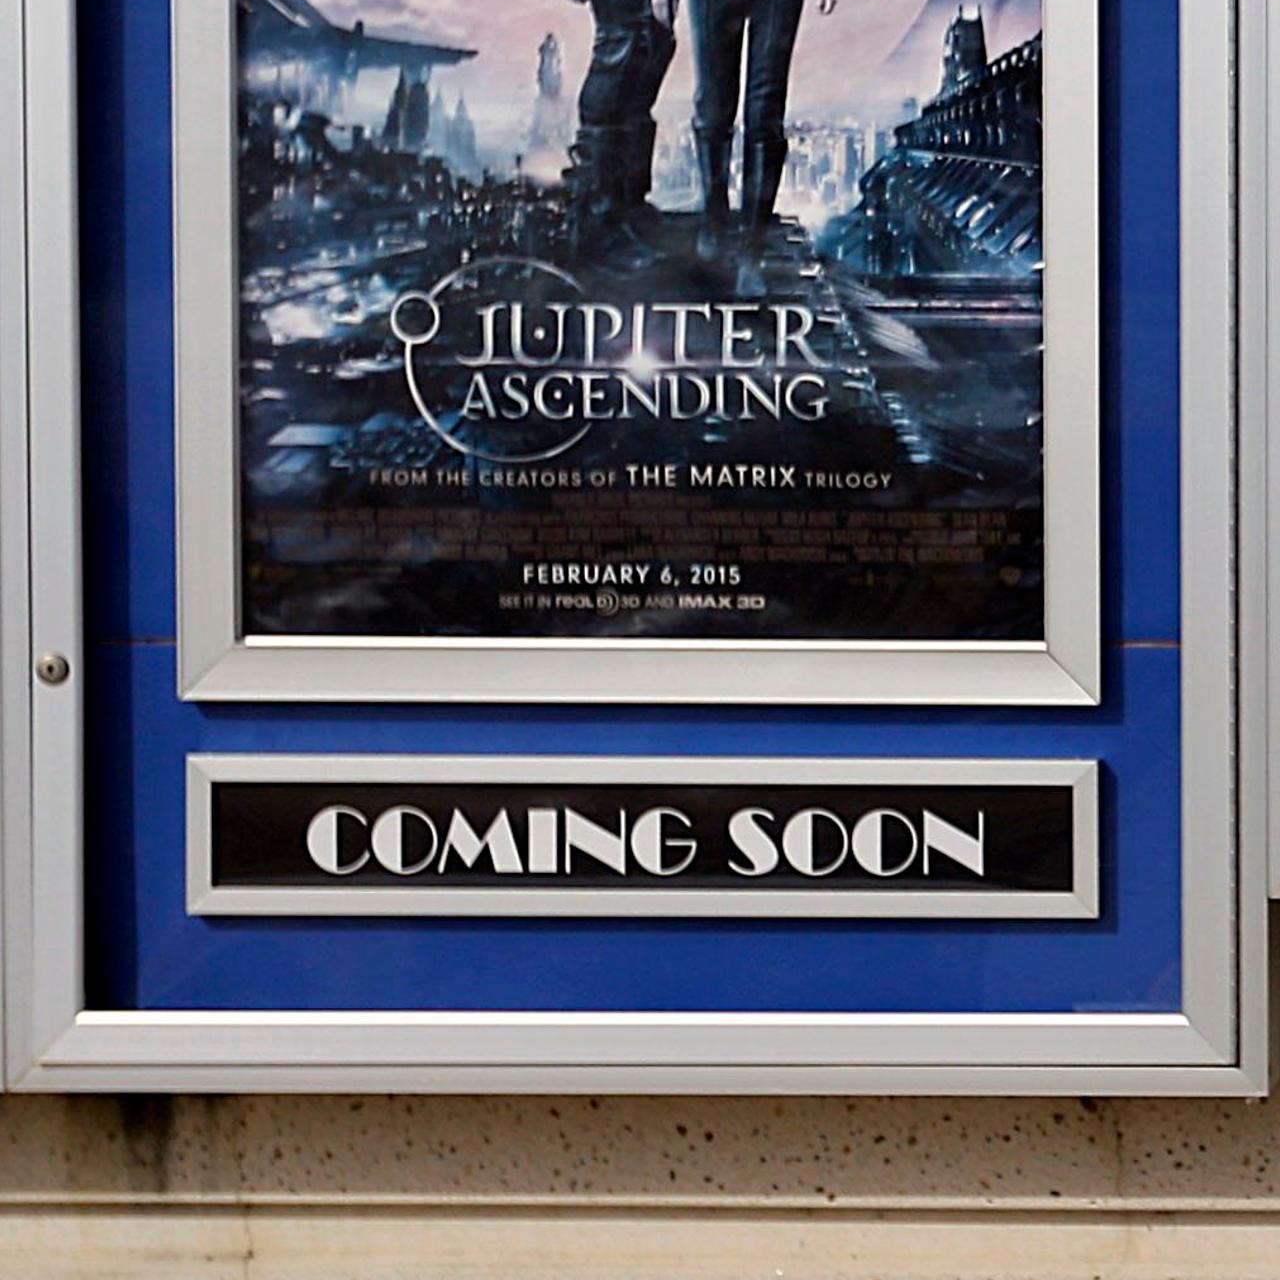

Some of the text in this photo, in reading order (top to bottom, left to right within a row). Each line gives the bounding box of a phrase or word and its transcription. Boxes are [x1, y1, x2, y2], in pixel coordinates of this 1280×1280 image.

[456, 301, 834, 369] JUPITER
[460, 372, 829, 421] ASCENDING
[369, 465, 892, 489] FROM THE CREATORS OF THE MATRIX TRILOGY
[523, 563, 741, 588] FEBRUARY 6, 2015
[679, 593, 732, 609] IMAX
[737, 594, 766, 609] 3D
[306, 803, 986, 877] COMING SOON
